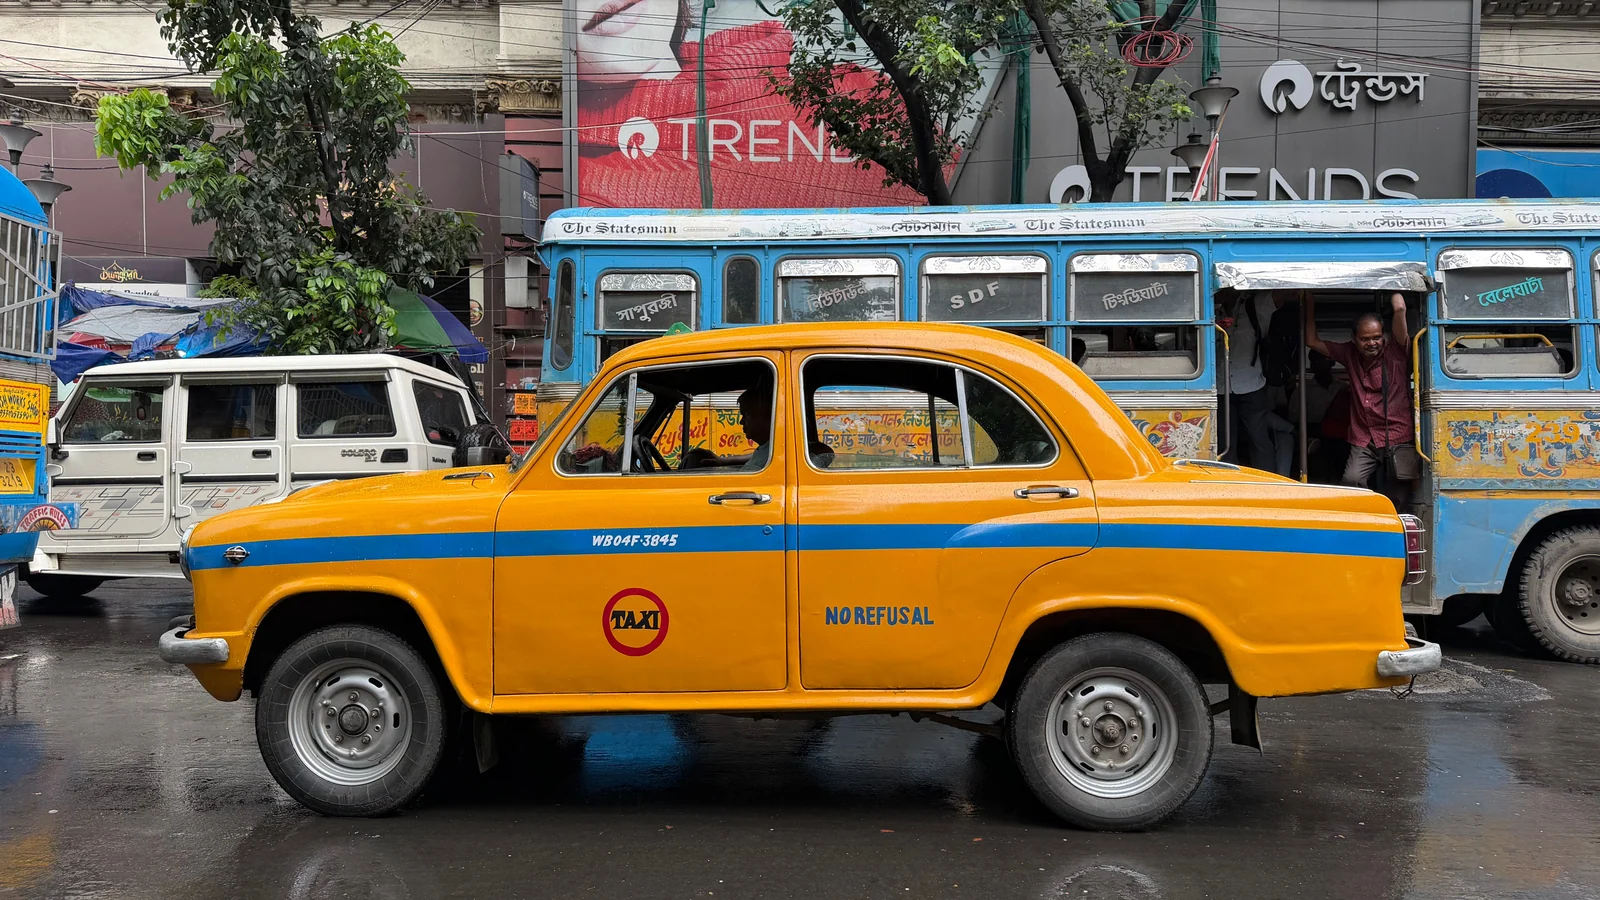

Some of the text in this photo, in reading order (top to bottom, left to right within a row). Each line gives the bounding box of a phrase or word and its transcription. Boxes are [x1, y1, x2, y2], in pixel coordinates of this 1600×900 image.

[1316, 57, 1430, 111] ট্রেন্ডস
[562, 222, 677, 235] The Statesman
[891, 219, 961, 232] স্টেটসম্যান
[1024, 218, 1055, 232] The
[1058, 217, 1146, 231] Statesman
[1373, 215, 1447, 228] স্টেটসম্যান
[1515, 211, 1600, 225] The State
[950, 280, 1000, 310] SDF
[1477, 276, 1545, 307] বেলেঘাটা
[615, 293, 678, 322] সাপুরজী
[1525, 423, 1580, 444] 239
[20, 507, 67, 531] TRAFFIC RULES
[610, 609, 661, 630] TAXI
[825, 606, 935, 625] NO REFUSAL
